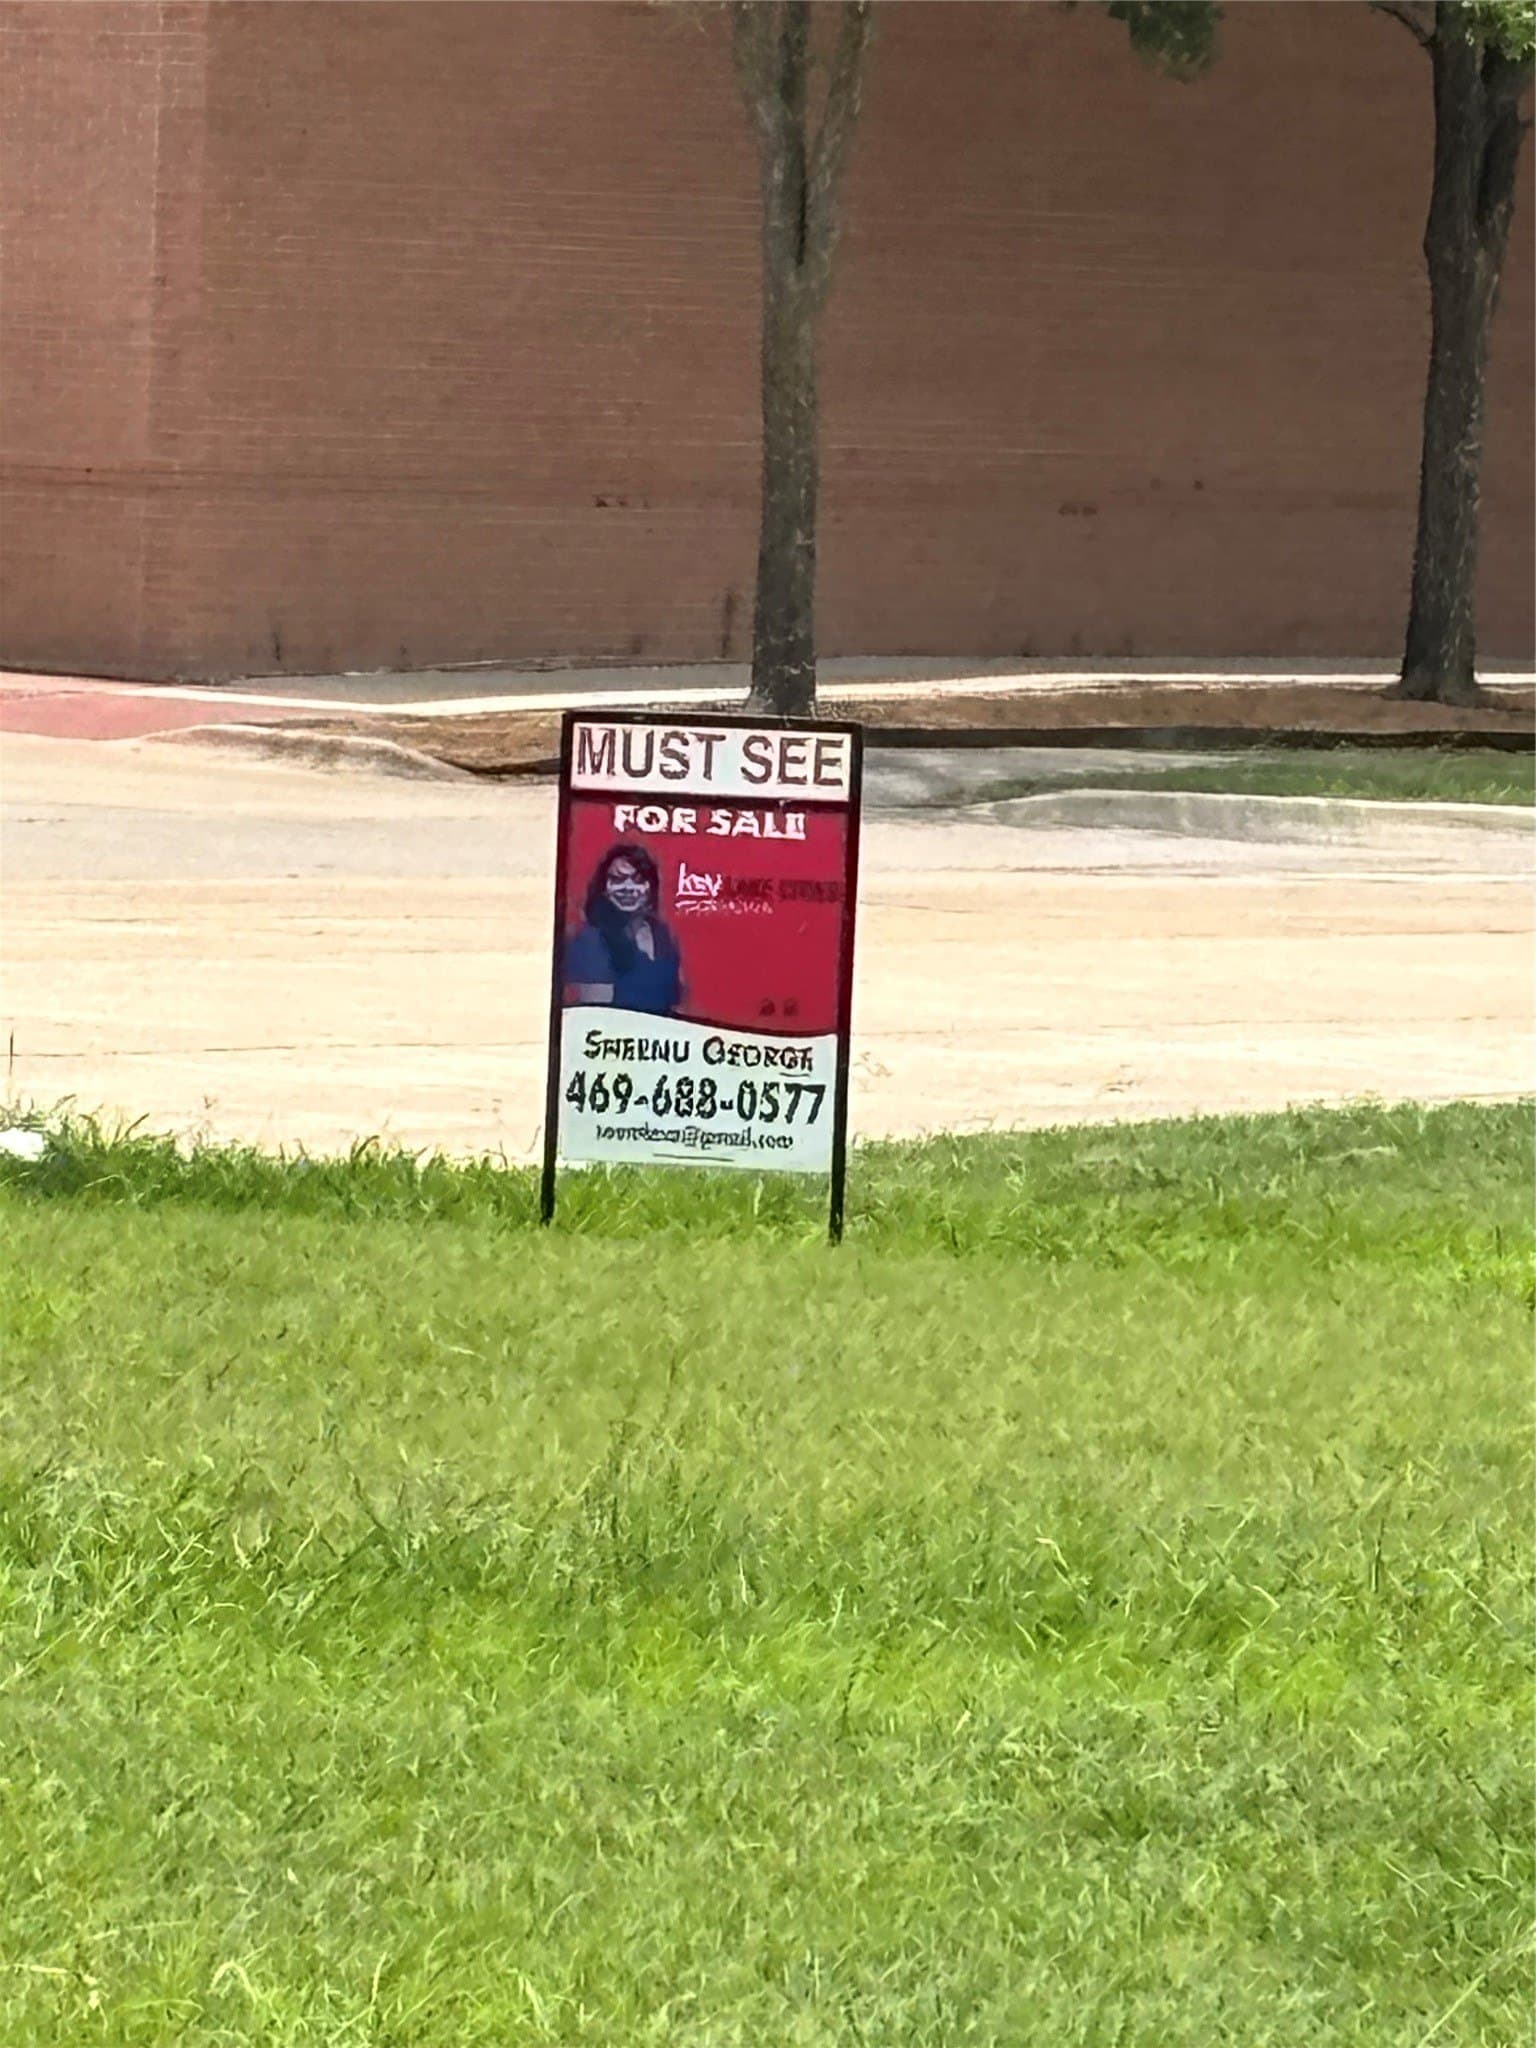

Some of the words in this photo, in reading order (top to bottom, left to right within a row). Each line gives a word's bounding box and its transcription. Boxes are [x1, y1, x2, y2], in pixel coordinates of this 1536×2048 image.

[577, 726, 726, 781] MUST
[741, 734, 844, 787] SEE
[613, 804, 697, 833] FOR
[565, 1070, 827, 1126] 469-688-0577
